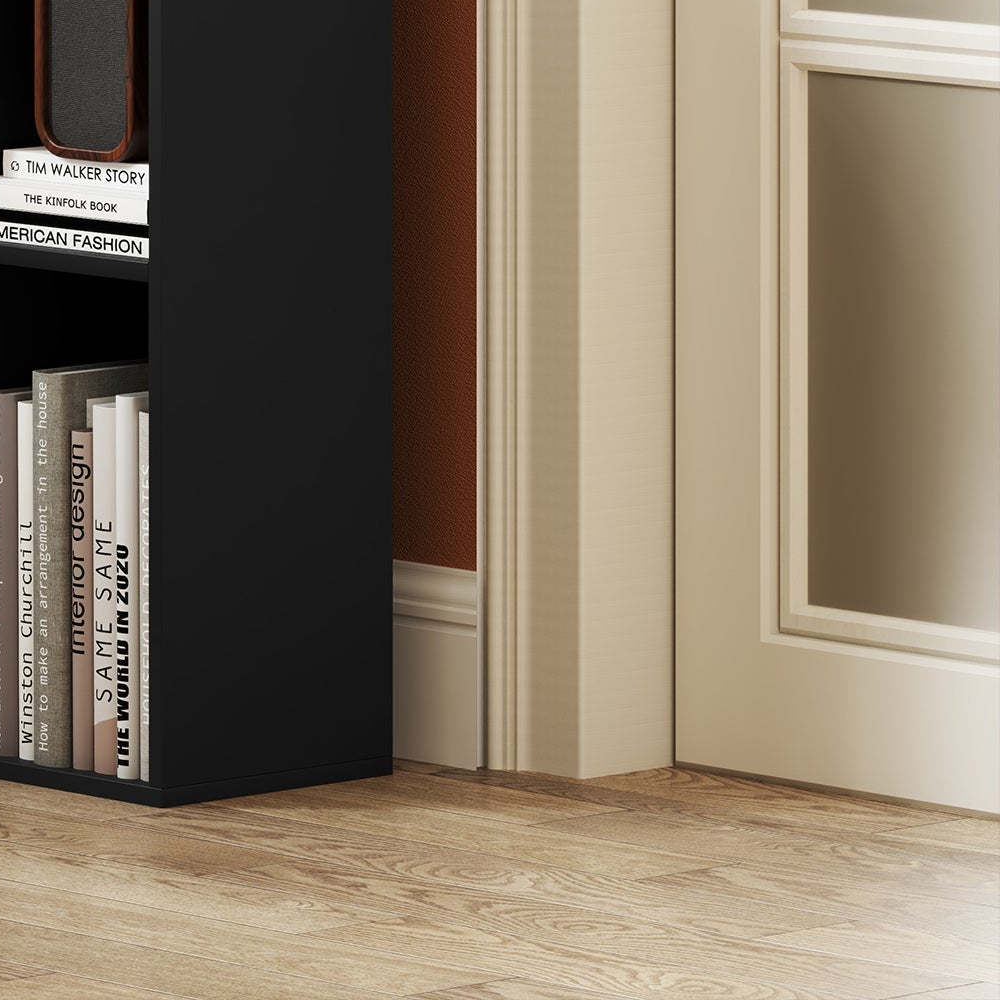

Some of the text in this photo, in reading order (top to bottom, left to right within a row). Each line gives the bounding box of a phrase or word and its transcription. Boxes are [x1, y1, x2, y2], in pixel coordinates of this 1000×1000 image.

[24, 193, 118, 213] THE KINFOLK BOOK
[26, 160, 146, 186] TIM WALKER STORY
[73, 235, 143, 255] FASHION
[20, 521, 33, 744] Winston Churchill
[37, 382, 51, 751] How to make an arrangement in the house
[72, 444, 91, 655] Interior design
[95, 519, 112, 703] SAME SAME
[116, 544, 129, 768] THE WORLD IN 2020
